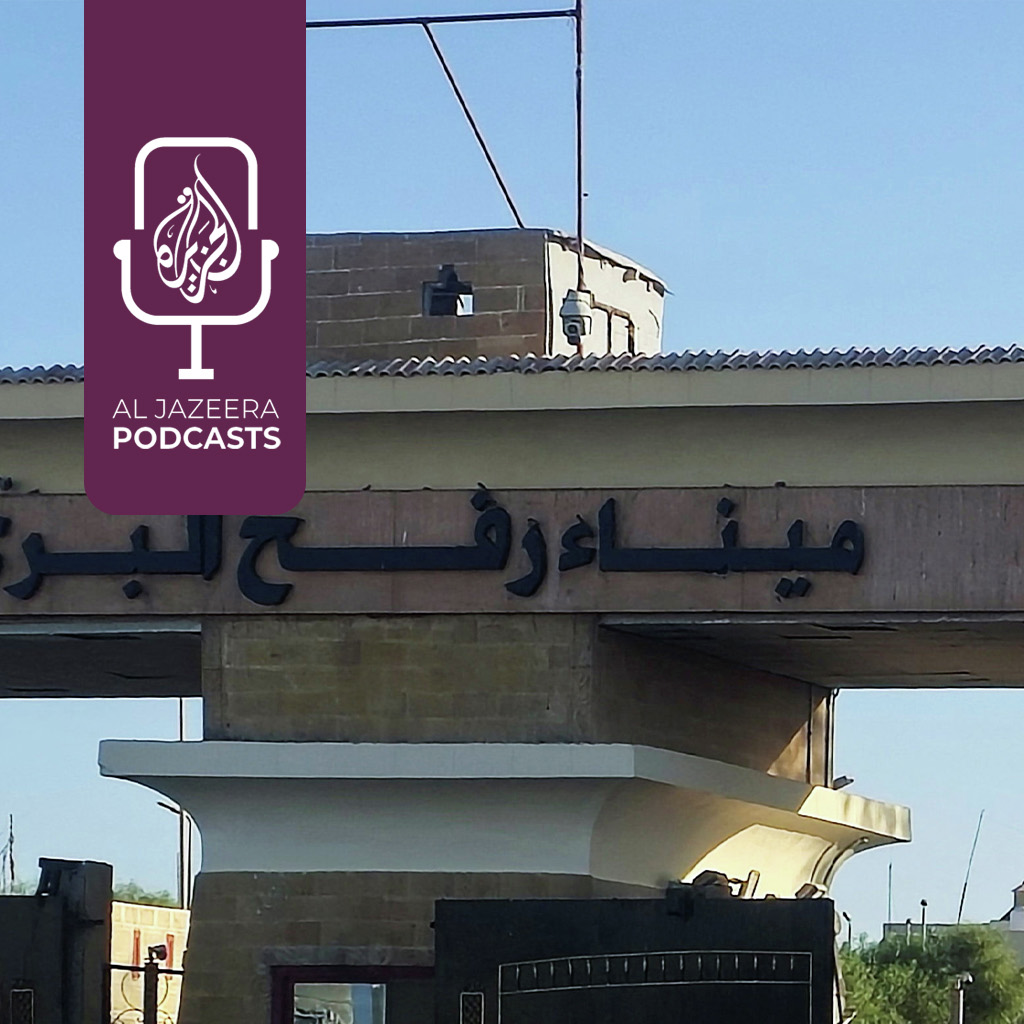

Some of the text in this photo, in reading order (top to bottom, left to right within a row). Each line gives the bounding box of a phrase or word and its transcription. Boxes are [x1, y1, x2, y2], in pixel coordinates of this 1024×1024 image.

[0, 484, 865, 606] ميناء رفح البر
